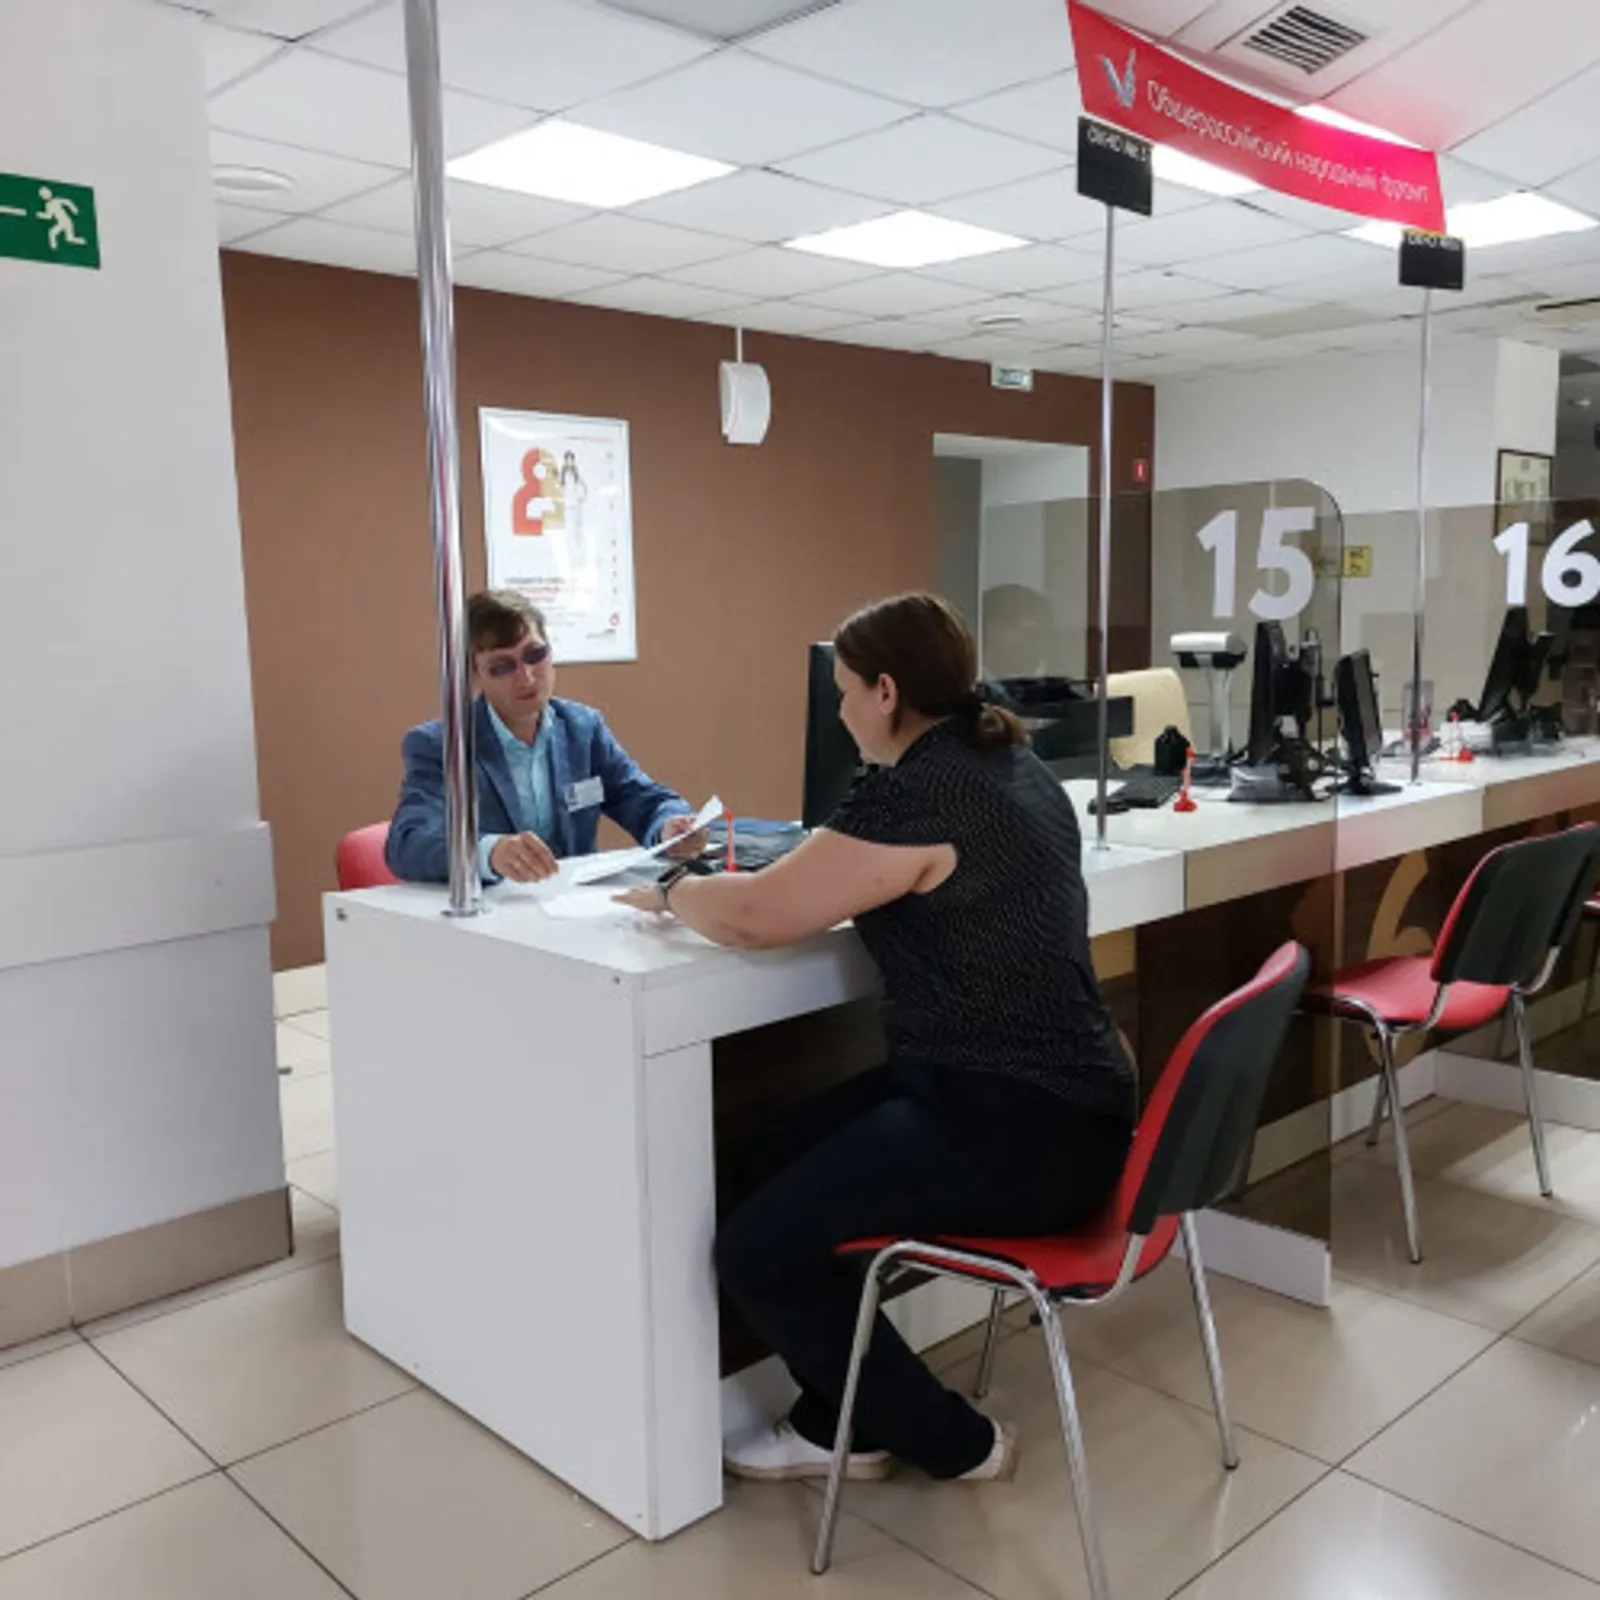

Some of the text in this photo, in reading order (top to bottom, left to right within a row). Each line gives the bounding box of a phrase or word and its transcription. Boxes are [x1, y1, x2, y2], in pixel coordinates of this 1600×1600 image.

[1147, 79, 1294, 168] Общероссийский
[1295, 151, 1377, 191] народный
[1380, 171, 1429, 204] фронт
[1196, 507, 1316, 620] 15
[1492, 519, 1600, 607] 16
